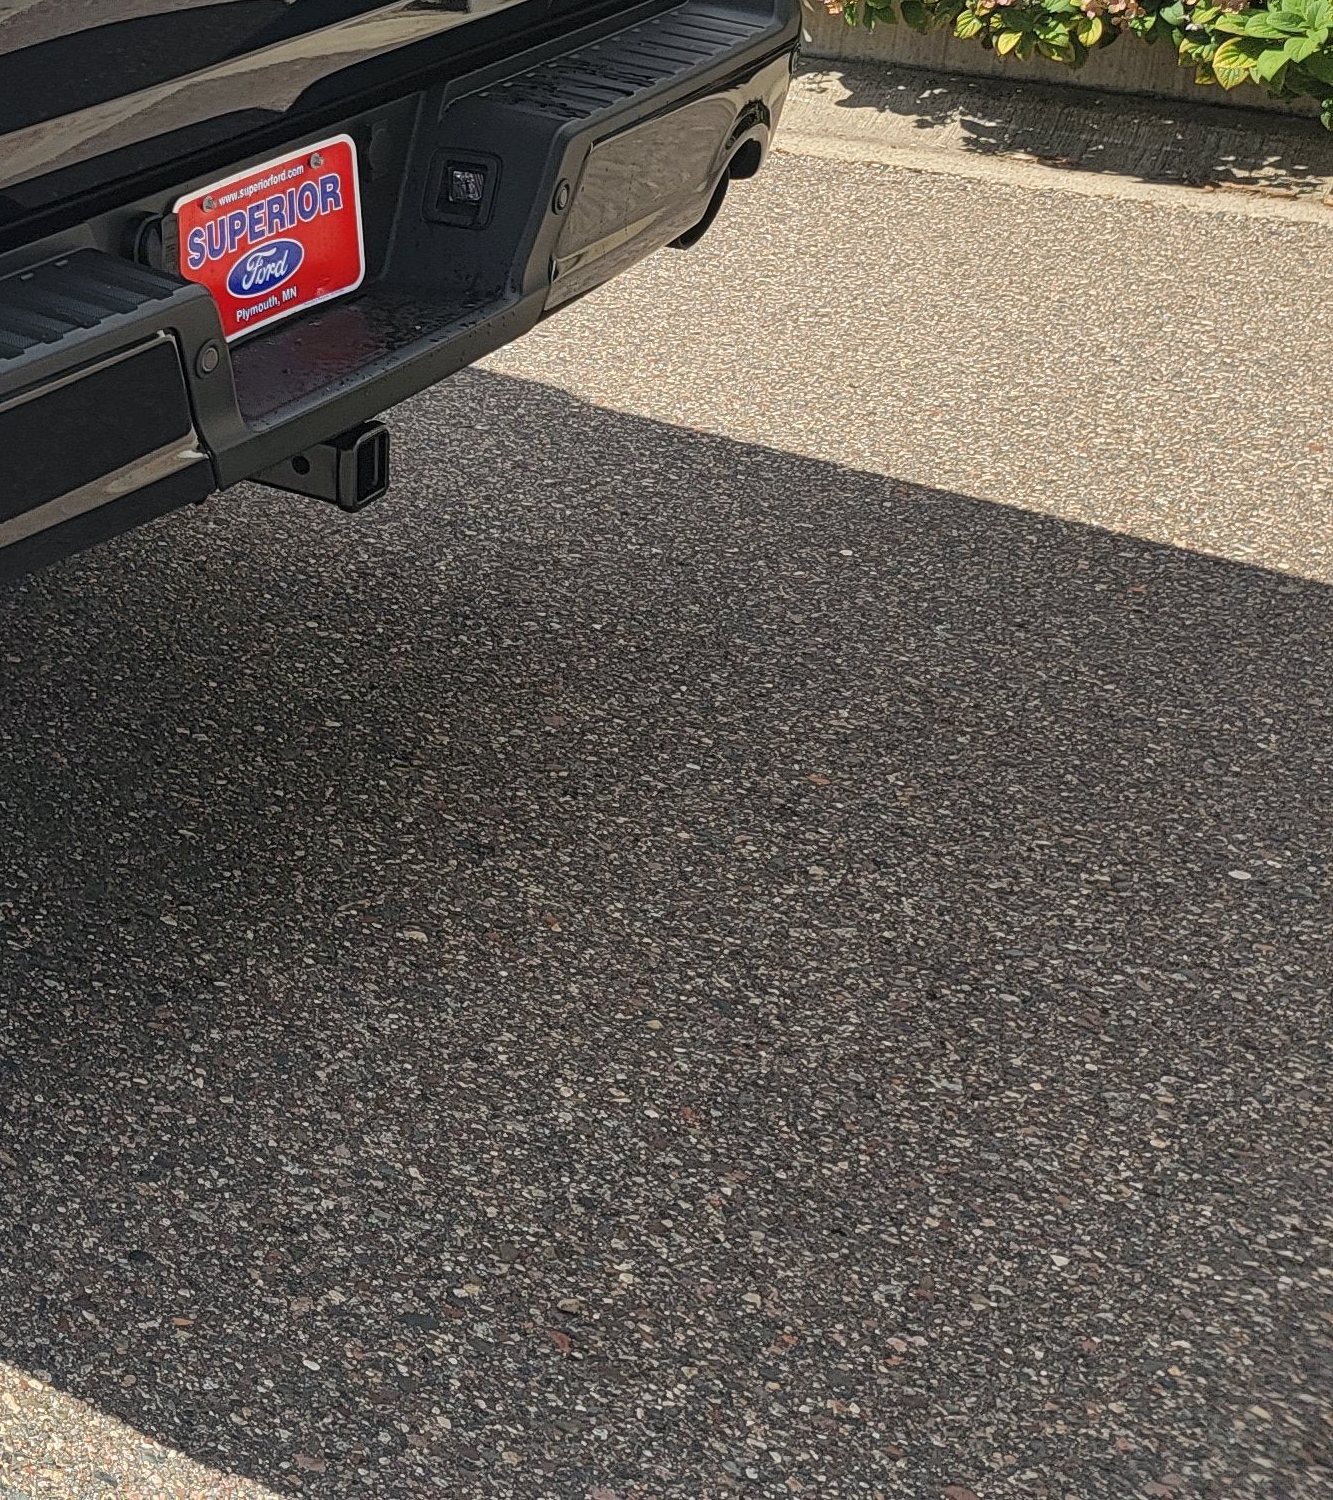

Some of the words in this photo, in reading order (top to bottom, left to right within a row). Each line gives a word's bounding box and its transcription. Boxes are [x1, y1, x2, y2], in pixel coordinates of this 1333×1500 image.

[218, 164, 305, 206] www.superiorford.com
[187, 172, 344, 270] SUPERIOR
[242, 247, 289, 291] Ford
[236, 295, 281, 322] Plymouth,
[282, 286, 297, 302] MN
